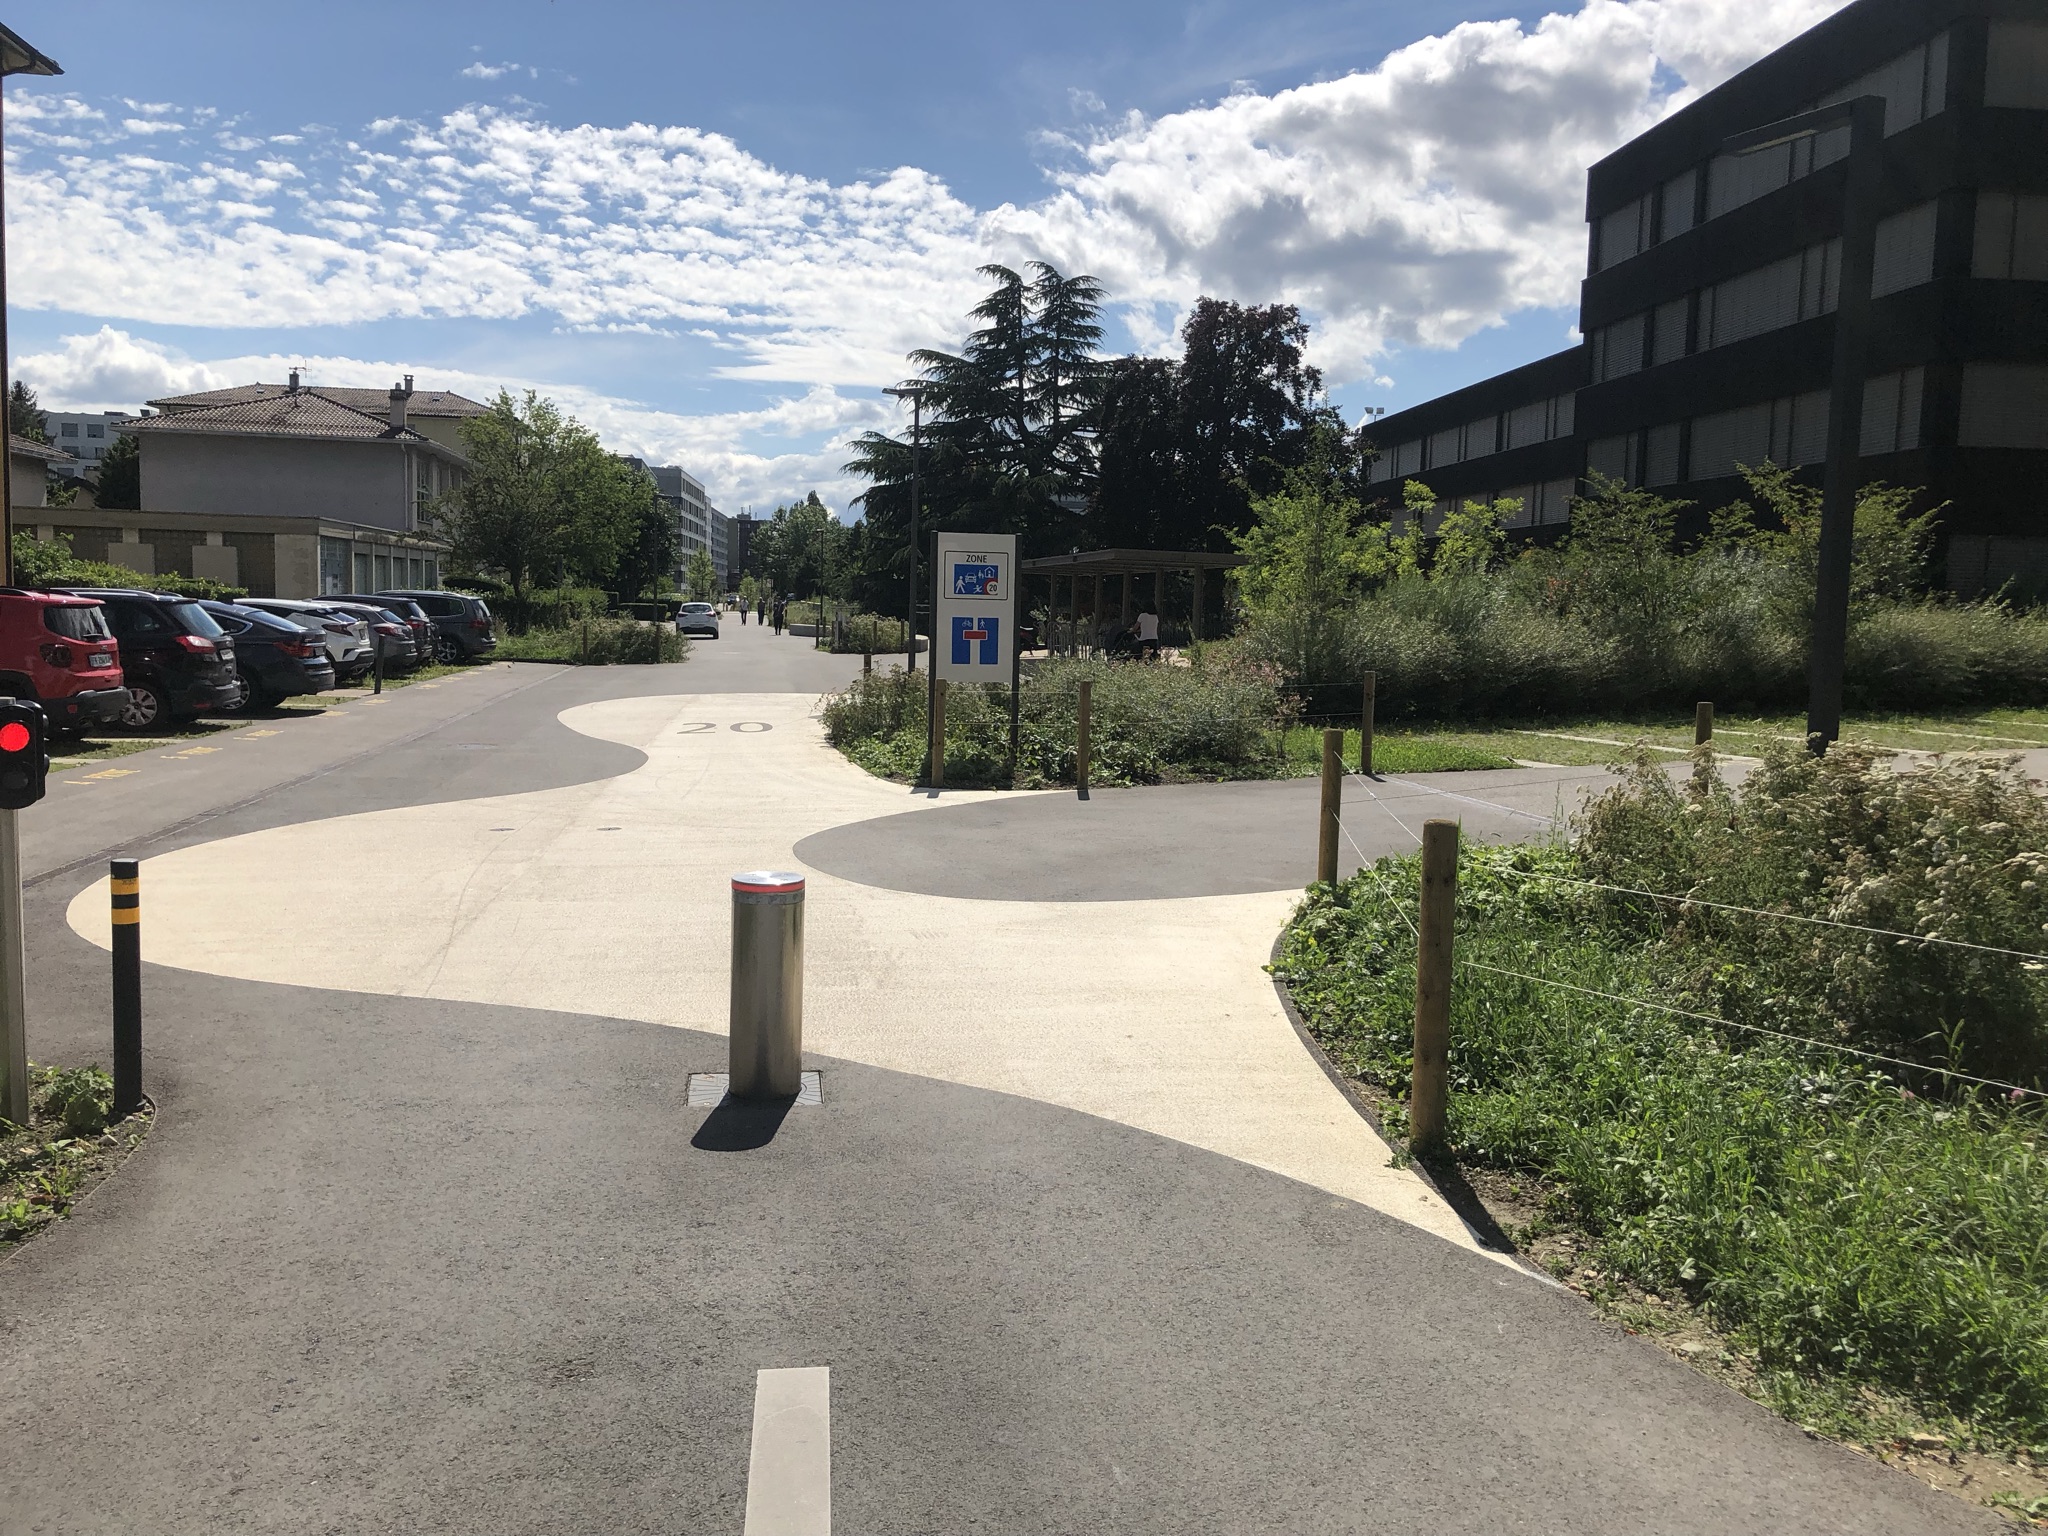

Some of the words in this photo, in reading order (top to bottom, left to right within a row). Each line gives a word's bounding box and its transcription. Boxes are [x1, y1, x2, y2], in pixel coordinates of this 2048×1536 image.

[966, 555, 987, 563] ZONE
[989, 584, 998, 592] 20
[677, 722, 773, 734] 20
